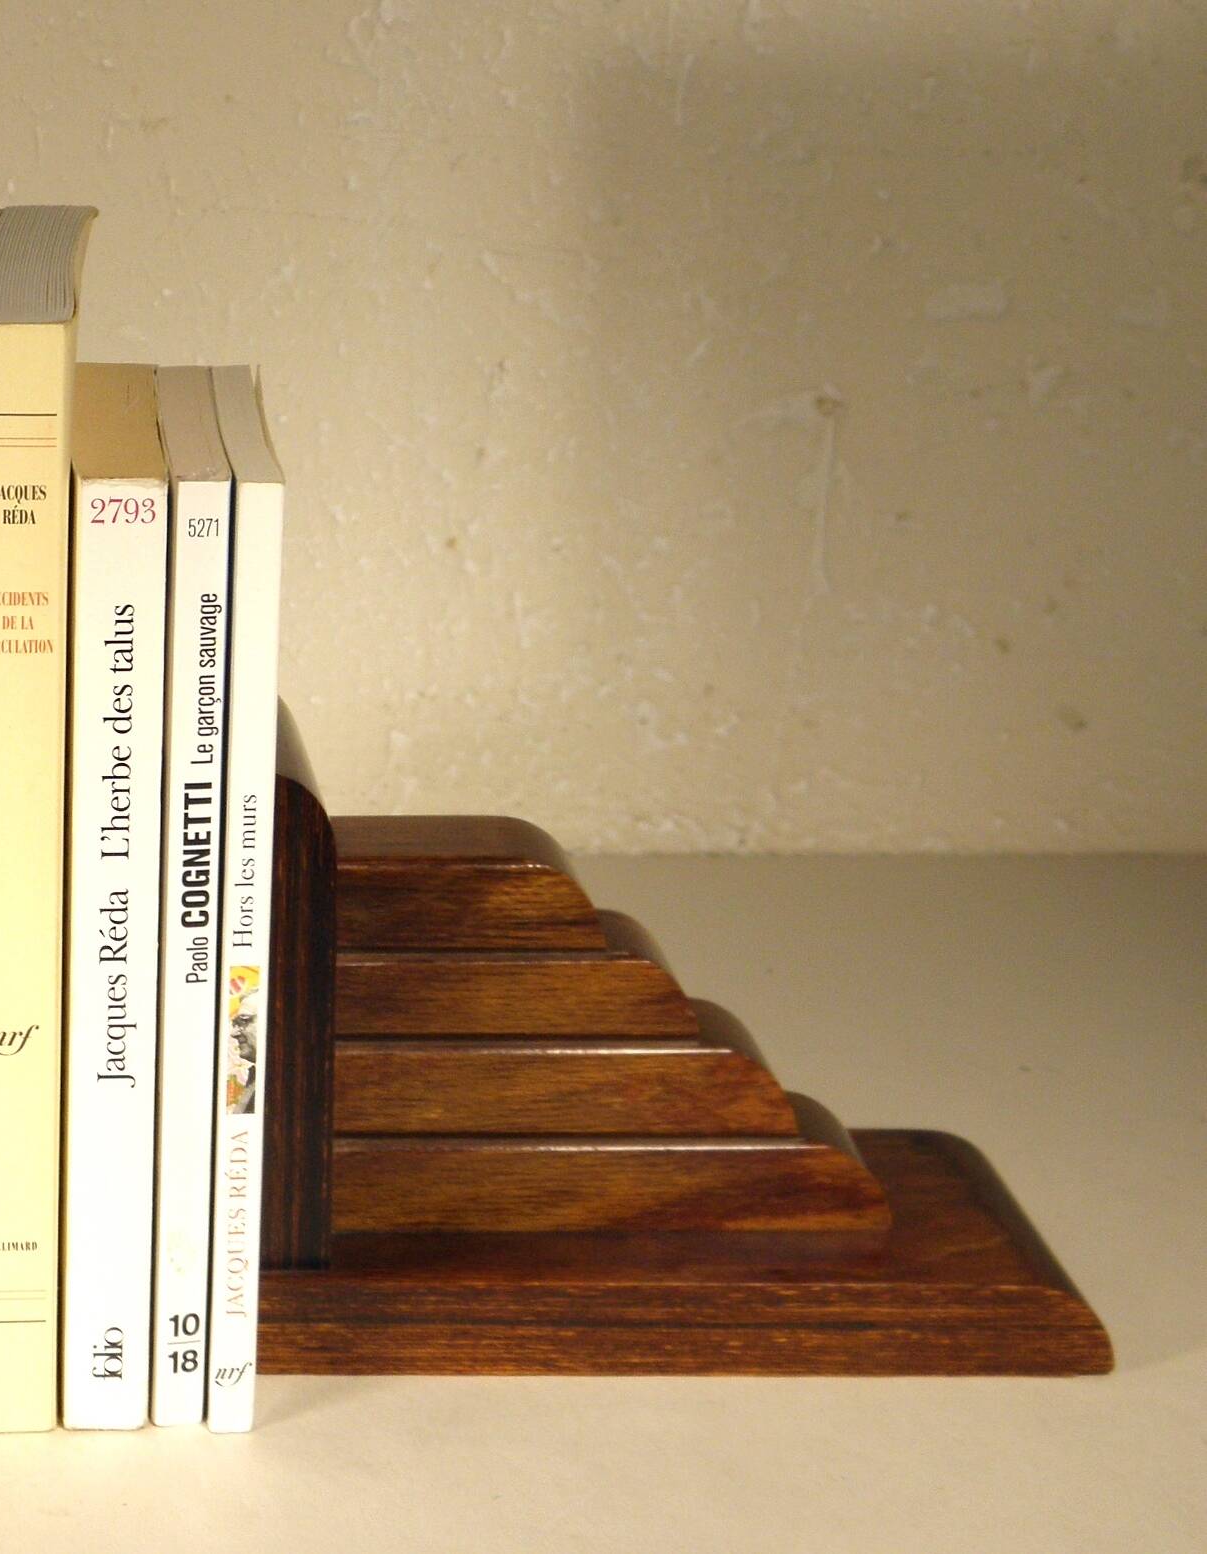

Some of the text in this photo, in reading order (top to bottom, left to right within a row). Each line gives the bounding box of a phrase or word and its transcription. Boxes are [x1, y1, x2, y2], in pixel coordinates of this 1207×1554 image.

[2, 504, 36, 525] RÉDA
[90, 497, 156, 525] 2793
[187, 517, 220, 539] 5271
[2, 615, 34, 631] DE LA
[190, 593, 223, 765] Le garçon sauvage
[100, 604, 135, 858] L'herbe des talus
[180, 781, 213, 984] Paolo COGNETTI
[232, 794, 257, 947] Hors les murs
[96, 889, 137, 1089] Jacques Réda
[224, 1130, 250, 1318] JACQUES RÉDA
[168, 1312, 201, 1338] 10
[92, 1326, 123, 1380] folio
[168, 1349, 199, 1374] 18
